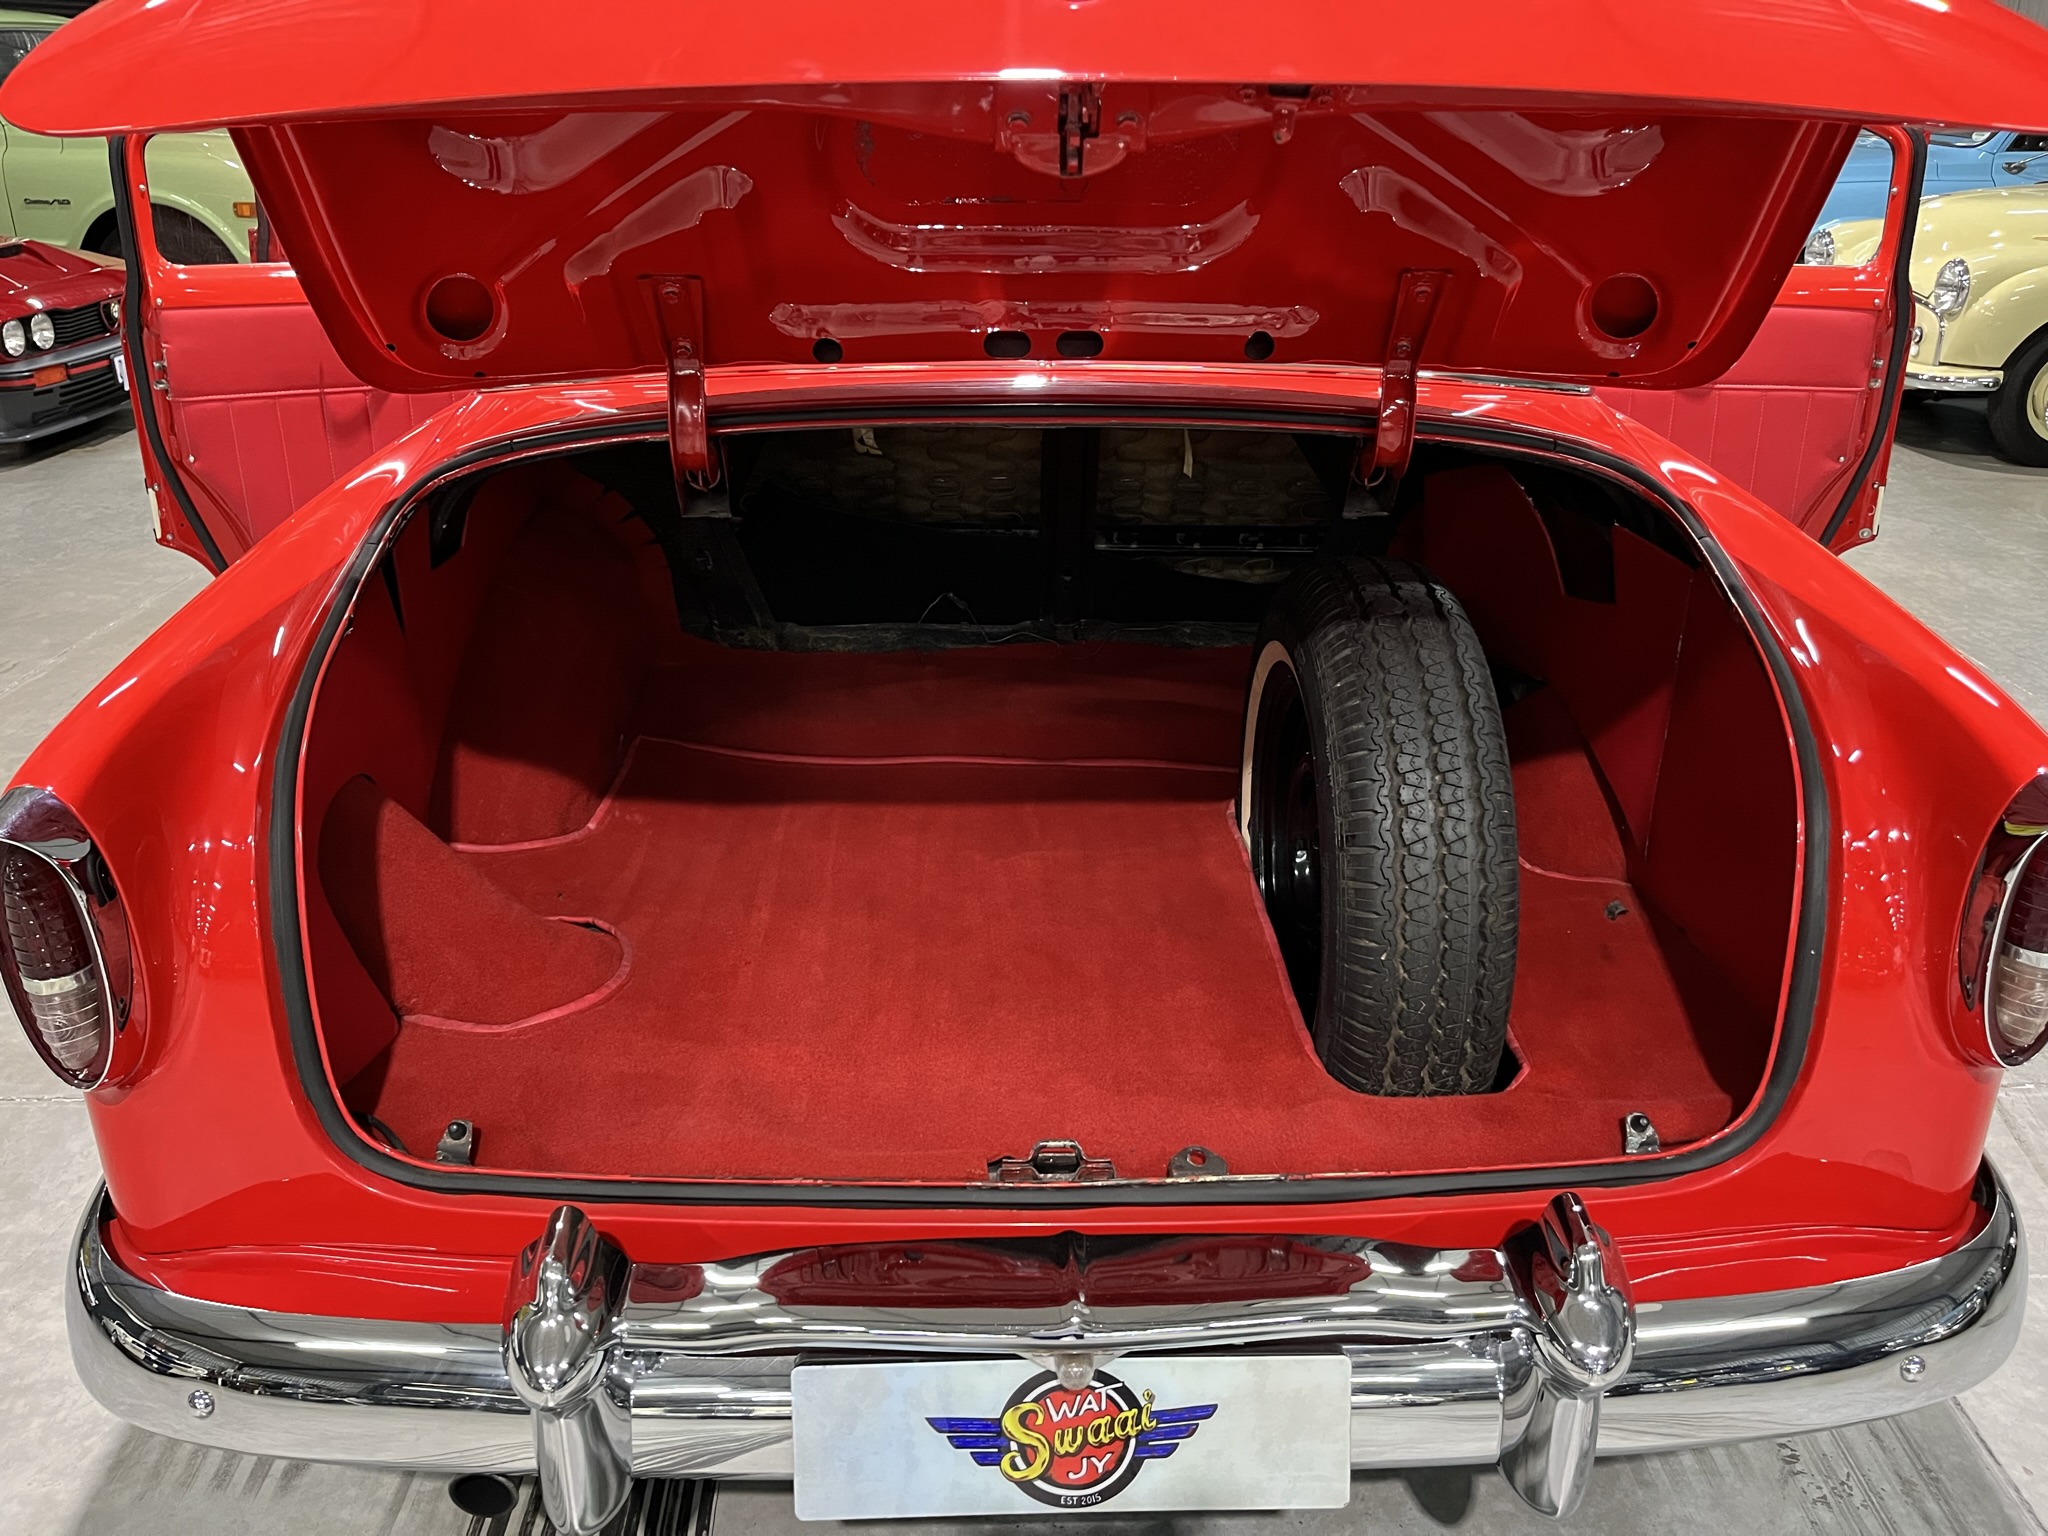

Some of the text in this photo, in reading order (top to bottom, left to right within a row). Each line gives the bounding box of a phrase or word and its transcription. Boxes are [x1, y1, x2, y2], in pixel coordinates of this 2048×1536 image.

[1046, 1382, 1123, 1422] WAT
[1000, 1389, 1157, 1481] Swaai
[1068, 1453, 1112, 1480] JY
[1060, 1493, 1102, 1505] EST 2015
